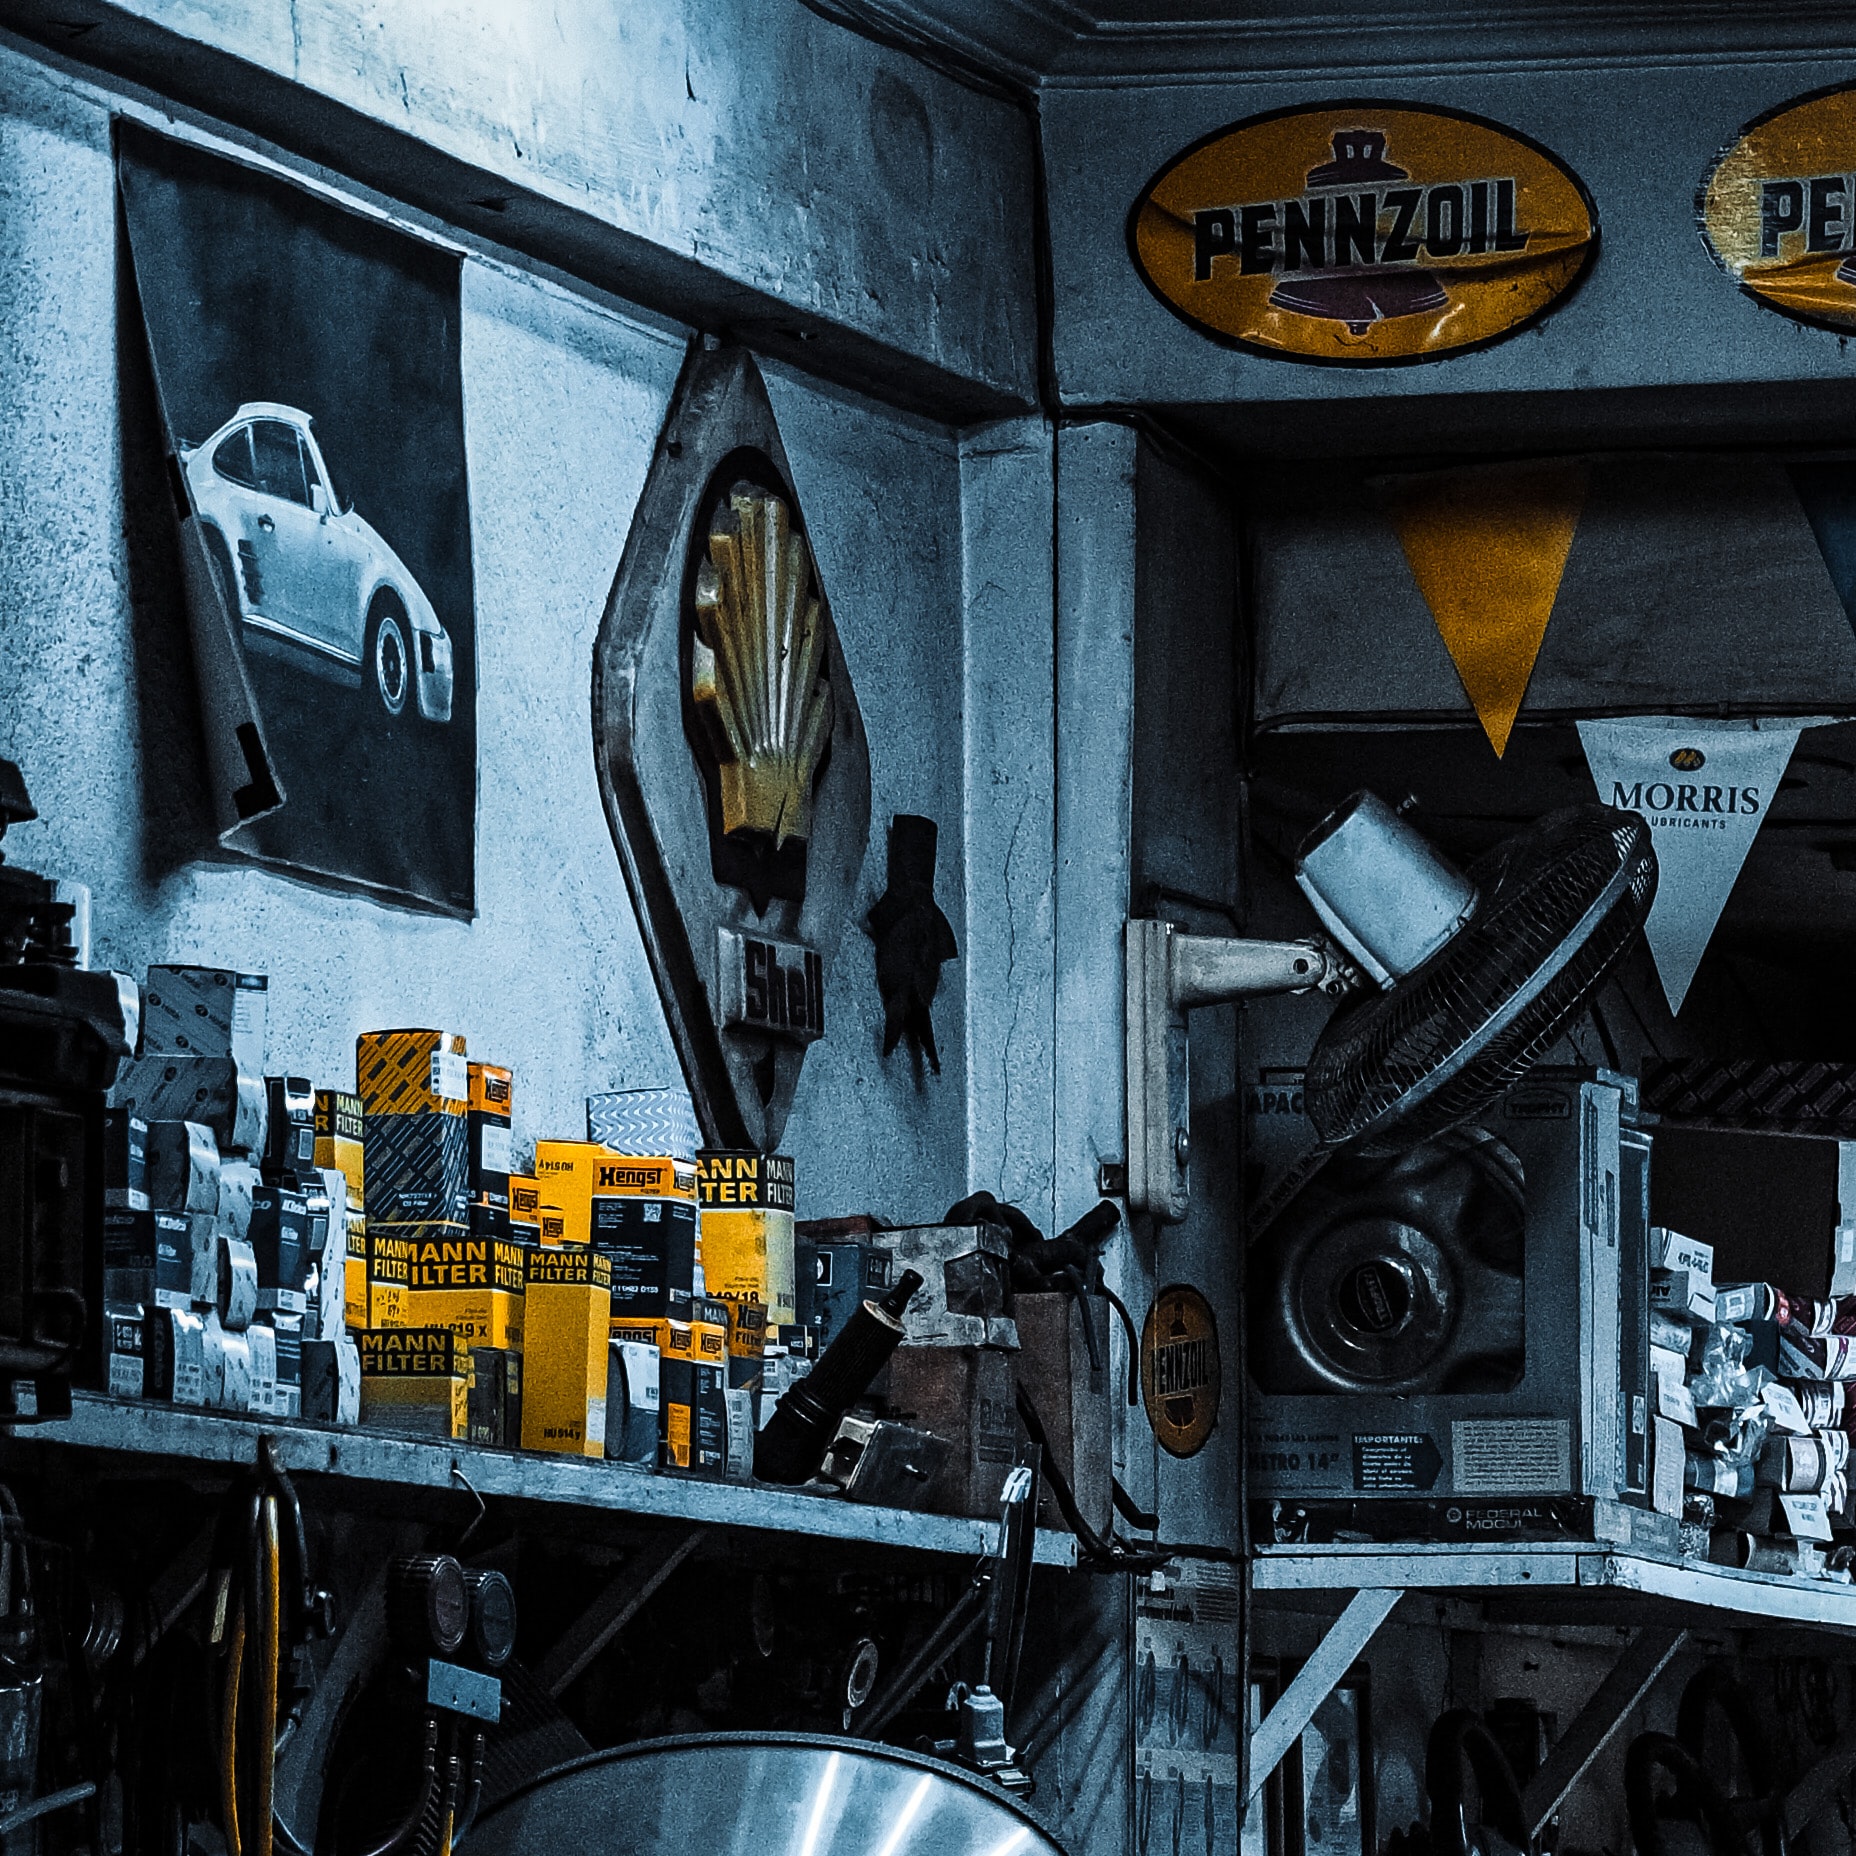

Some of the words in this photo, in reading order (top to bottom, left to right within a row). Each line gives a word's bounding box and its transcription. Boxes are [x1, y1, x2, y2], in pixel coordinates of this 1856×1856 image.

[1194, 177, 1531, 282] PENNZOIL
[1611, 780, 1760, 816] MORRIS
[746, 939, 824, 1033] Shell
[336, 1093, 364, 1114] MANN
[336, 1117, 364, 1138] FILTER
[600, 1166, 662, 1188] Hengst
[494, 1241, 524, 1267] MANN
[529, 1253, 588, 1267] MANN
[411, 1264, 488, 1285] ILTER
[529, 1267, 588, 1282] FILTER
[362, 1335, 446, 1353] MANN
[362, 1354, 446, 1372] FILTER
[1466, 1508, 1543, 1520] FEDERAL
